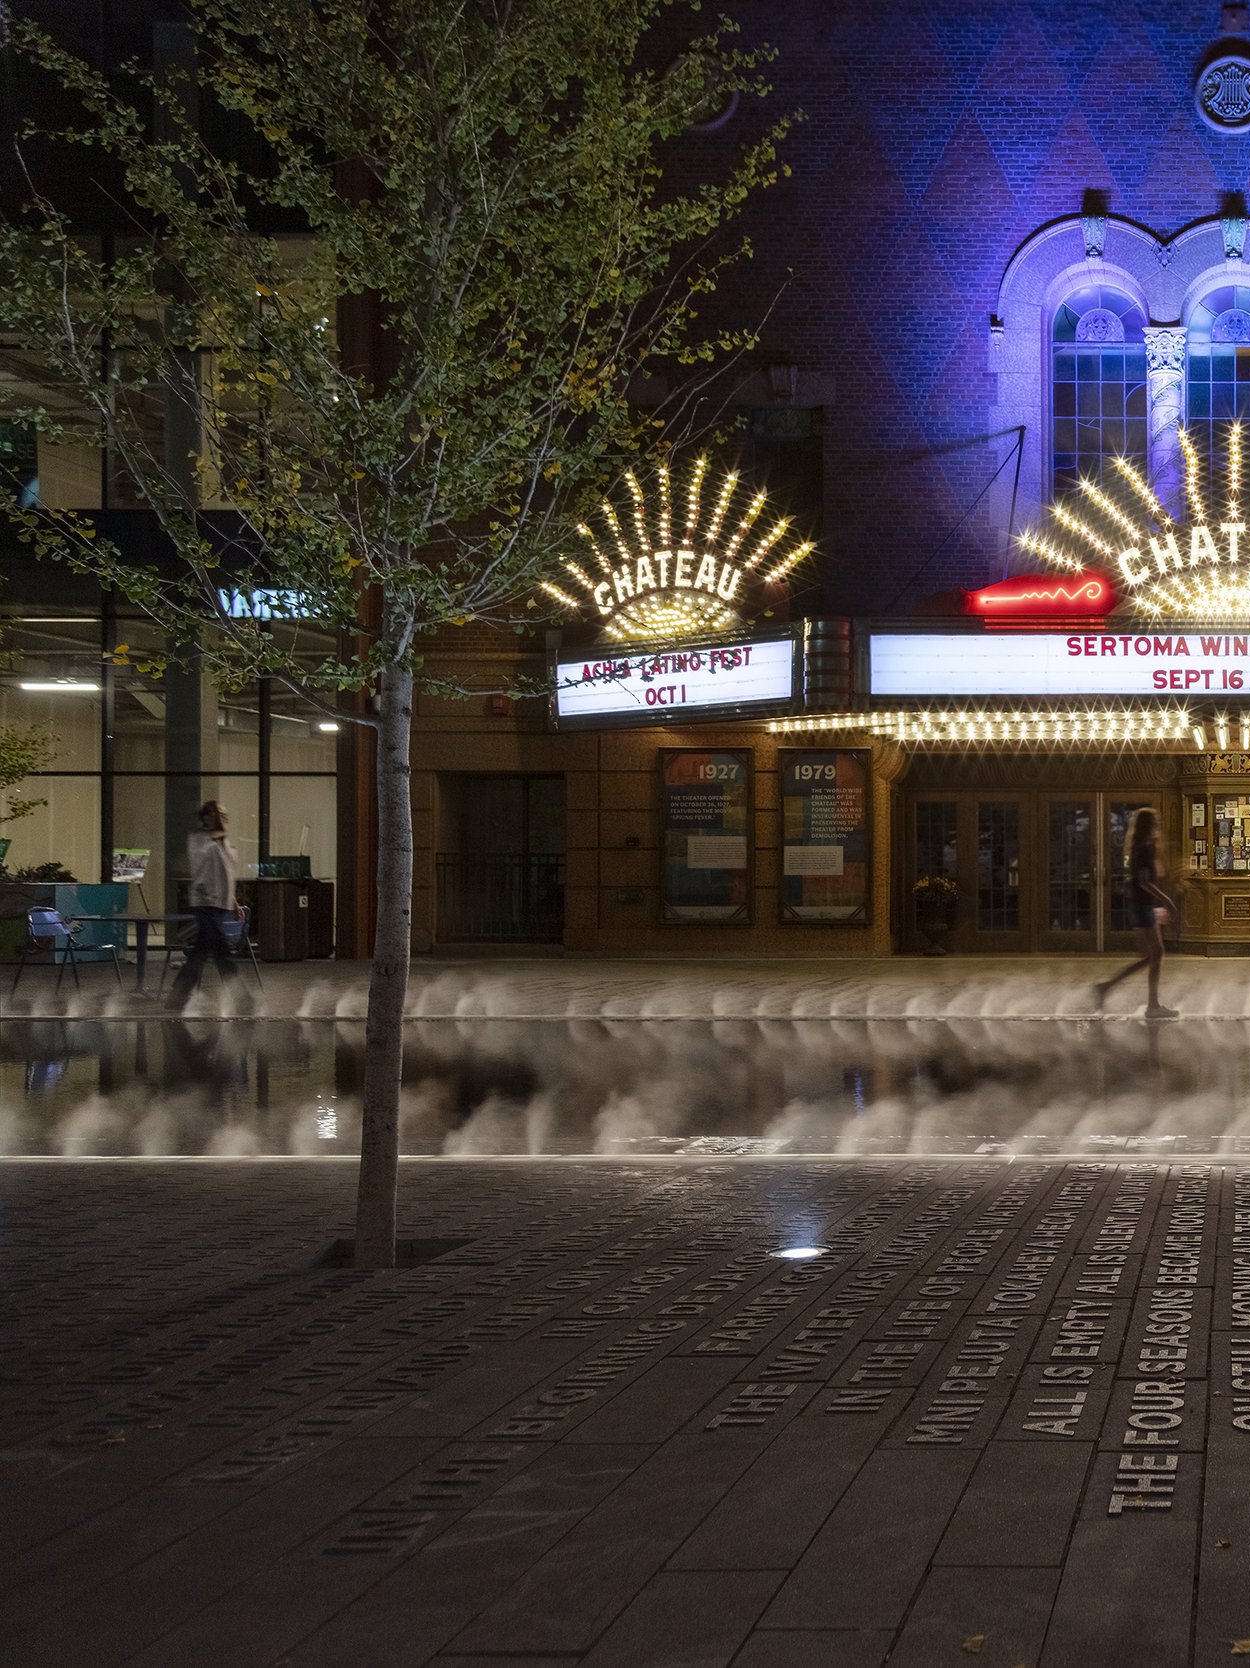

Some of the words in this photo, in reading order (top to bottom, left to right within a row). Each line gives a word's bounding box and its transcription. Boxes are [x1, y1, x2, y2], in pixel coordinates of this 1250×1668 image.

[593, 550, 742, 615] CHATEAU
[641, 651, 701, 677] LATINO
[710, 646, 753, 670] FEST
[1066, 636, 1191, 657] SERTOMA
[645, 685, 676, 706] OCT
[1152, 669, 1214, 690] SEPT
[1222, 669, 1244, 690] 16
[699, 764, 739, 779] 1927
[794, 764, 836, 780] 1979
[1028, 1211, 1082, 1236] HECA
[1090, 1216, 1142, 1250] SILENT
[1165, 1205, 1207, 1232] MOON
[933, 1229, 1006, 1271] PEOPLE
[1084, 1254, 1128, 1264] IS
[1153, 1235, 1203, 1283] BECAME
[826, 1271, 903, 1302] WAS
[915, 1276, 972, 1295] OF
[981, 1240, 1067, 1310] TOKAHEYA
[1071, 1268, 1126, 1293] ALL
[684, 1287, 813, 1351] FARMER
[769, 1255, 848, 1282] GOD
[880, 1300, 955, 1336] LIFE
[751, 1307, 872, 1375] WATER
[1045, 1299, 1117, 1356] EMPTY
[1132, 1289, 1197, 1372] SEASONS
[474, 1320, 699, 1435] BEGINNING
[654, 1294, 727, 1313] DE
[845, 1342, 928, 1382] THE
[930, 1316, 1029, 1392] PEJUTA
[1036, 1366, 1097, 1384] IS
[700, 1382, 805, 1428] THE
[821, 1388, 896, 1412] IN
[1015, 1391, 1091, 1435] ALL
[1120, 1381, 1190, 1445] FOUR
[902, 1398, 987, 1443] MNI
[1106, 1455, 1183, 1512] THE
